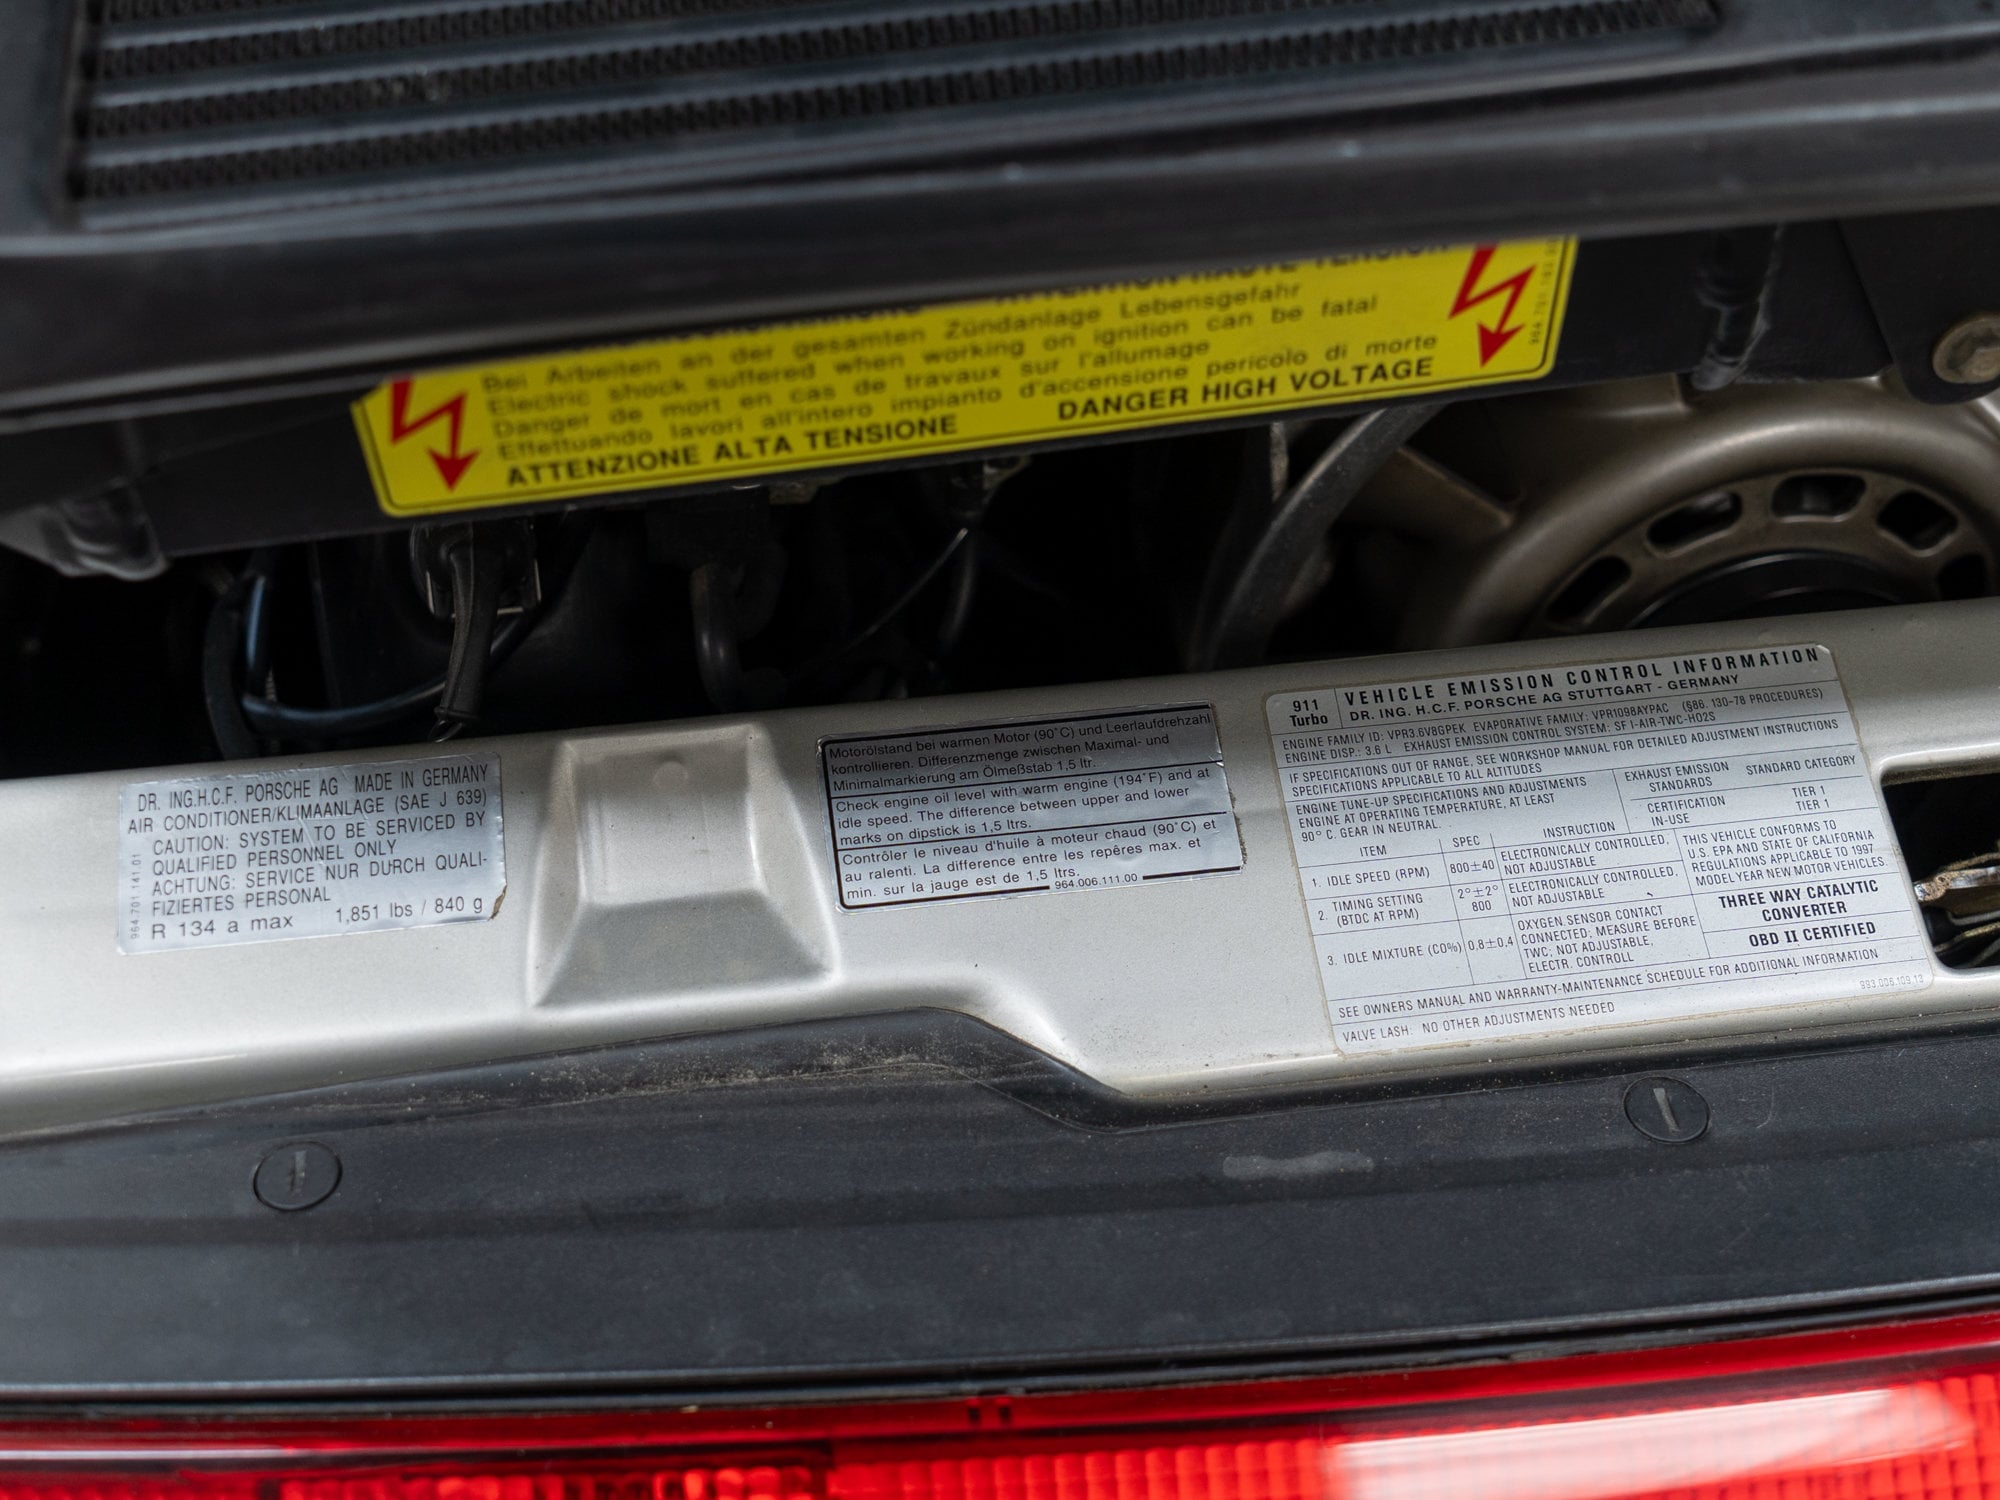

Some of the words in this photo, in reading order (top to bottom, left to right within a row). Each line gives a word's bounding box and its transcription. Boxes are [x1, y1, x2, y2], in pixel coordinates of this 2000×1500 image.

[943, 307, 1102, 344] Zündanlage
[1118, 282, 1301, 325] Lebensgefahr
[485, 389, 591, 417] Electric
[606, 377, 688, 403] shock
[704, 357, 817, 391] suffered
[832, 352, 906, 376] when
[923, 339, 1026, 366] working
[1042, 326, 1078, 352] on
[1092, 318, 1190, 349] ignition
[1205, 309, 1255, 333] can
[1269, 305, 1305, 325] be
[1320, 294, 1379, 318] fatal
[506, 444, 701, 487] ATTENZIONE
[713, 434, 794, 463] ALTA
[803, 413, 958, 451] TENSIONE
[1057, 386, 1189, 421] DANGER
[1201, 375, 1278, 404] HIGH
[1289, 356, 1434, 393] VOLTAGE
[1344, 684, 1435, 706] VEHICLE
[1446, 674, 1554, 697] EMISSION
[1566, 662, 1662, 686] CONTROL
[1672, 647, 1819, 675] INFORMATION
[1292, 698, 1319, 713] 911
[1349, 710, 1375, 722] DR.
[1378, 706, 1411, 719] ING.
[1463, 694, 1538, 711] PORSCHE
[1542, 692, 1563, 704] AG
[1567, 682, 1652, 701] STUTTGART
[1667, 674, 1738, 691] GERMANY
[1289, 713, 1329, 727] Turbo
[1624, 766, 1675, 782] EXHAUST
[1674, 761, 1730, 778] EMISSION
[1745, 760, 1802, 776] STANDARD
[1804, 754, 1856, 770] CATEGORY
[137, 792, 161, 813] DR.
[245, 779, 312, 803] PORSCHE
[319, 777, 339, 797] AG
[354, 772, 393, 793] MADE
[401, 770, 414, 789] IN
[422, 764, 488, 788] GERMANY
[835, 797, 880, 813] Check
[883, 795, 929, 809] engine
[934, 791, 950, 804] oil
[954, 788, 986, 802] level
[990, 783, 1018, 799] with
[1022, 783, 1059, 795] warm
[1063, 775, 1109, 793] engine
[1167, 768, 1193, 782] and
[1197, 767, 1210, 779] at
[1295, 801, 1338, 816] ENGINE
[1339, 796, 1389, 811] TUNE-UP
[1392, 786, 1479, 806] SPECIFICATIONS
[1482, 784, 1506, 797] AND
[1508, 776, 1587, 794] ADJUSTMENTS
[1648, 775, 1713, 793] STANDARDS
[1791, 785, 1817, 798] TIER
[1819, 784, 1826, 795] 1
[127, 817, 154, 835] AIR
[163, 796, 385, 832] CONDITIONER/KLIMAANLAGE
[394, 792, 430, 815] (SAE
[439, 791, 447, 808] J
[456, 788, 487, 807] 639)
[837, 816, 862, 829] idle
[867, 811, 913, 828] speed.
[916, 809, 944, 822] The
[948, 804, 1016, 819] difference
[1019, 798, 1077, 812] between
[1081, 794, 1120, 808] upper
[1124, 788, 1150, 802] and
[1153, 787, 1190, 800] lower
[1298, 814, 1341, 829] ENGINE
[1344, 812, 1356, 825] AT
[1359, 806, 1420, 823] OPERATING
[1509, 796, 1521, 809] AT
[1523, 792, 1555, 806] LEAST
[1647, 795, 1726, 814] CERTIFICATION
[152, 834, 229, 856] CAUTION:
[239, 827, 304, 849] SYSTEM
[313, 824, 336, 842] TO
[345, 821, 366, 839] BE
[375, 813, 456, 837] SERVICED
[465, 810, 486, 828] BY
[839, 832, 882, 846] marks
[886, 831, 904, 842] on
[908, 824, 961, 842] dipstick
[964, 822, 976, 834] is
[981, 820, 1003, 836] 1,5
[1006, 819, 1032, 830] ltrs.
[1650, 812, 1691, 827] IN-USE
[1682, 832, 1709, 846] THIS
[1709, 827, 1757, 843] VEHICLE
[1759, 820, 1821, 838] CONFORMS
[1822, 818, 1837, 831] TO
[842, 849, 908, 866] Contrôler
[913, 847, 926, 859] le
[932, 844, 979, 857] niveau
[984, 837, 1030, 852] d'huile
[1036, 835, 1046, 847] à
[1050, 832, 1099, 845] moteur
[1104, 825, 1147, 840] chaud
[1202, 818, 1217, 831] et
[1359, 844, 1387, 857] ITEM
[1452, 835, 1481, 848] SPEC
[152, 853, 237, 877] QUALIFIED
[247, 844, 345, 868] PERSONNEL
[354, 838, 397, 859] ONLY
[151, 874, 235, 897] ACHTUNG:
[245, 866, 315, 889] SERVICE
[325, 862, 359, 881] NUR
[369, 856, 425, 878] DURCH
[435, 852, 488, 871] QUALI-
[1054, 872, 1138, 890] 964.006.111.00
[1326, 873, 1353, 887] IDLE
[1352, 870, 1391, 885] SPEED
[1395, 866, 1430, 882] (RPM)
[152, 894, 235, 917] FIZIERTES
[244, 886, 332, 909] PERSONAL
[1331, 896, 1374, 912] TIMING
[1373, 892, 1424, 908] SETTING
[1717, 891, 1767, 909] THREE
[1768, 887, 1801, 904] WAY
[1806, 879, 1879, 900] CATALYTIC
[335, 904, 379, 924] 1,851
[389, 902, 413, 919] lbs
[434, 896, 465, 914] 840
[472, 896, 483, 917] g
[1761, 900, 1848, 922] CONVERTER
[151, 922, 166, 940] R
[178, 919, 217, 937] 134
[226, 920, 239, 934] a
[250, 915, 293, 931] max
[1748, 932, 1780, 947] OBD
[1783, 929, 1799, 944] II
[1802, 921, 1876, 942] CERTIFIED
[1422, 1021, 1439, 1034] NO
[1442, 1016, 1481, 1032] OTHER
[1484, 1006, 1566, 1028] ADJUSTMENTS
[1568, 1001, 1615, 1017] NEEDED
